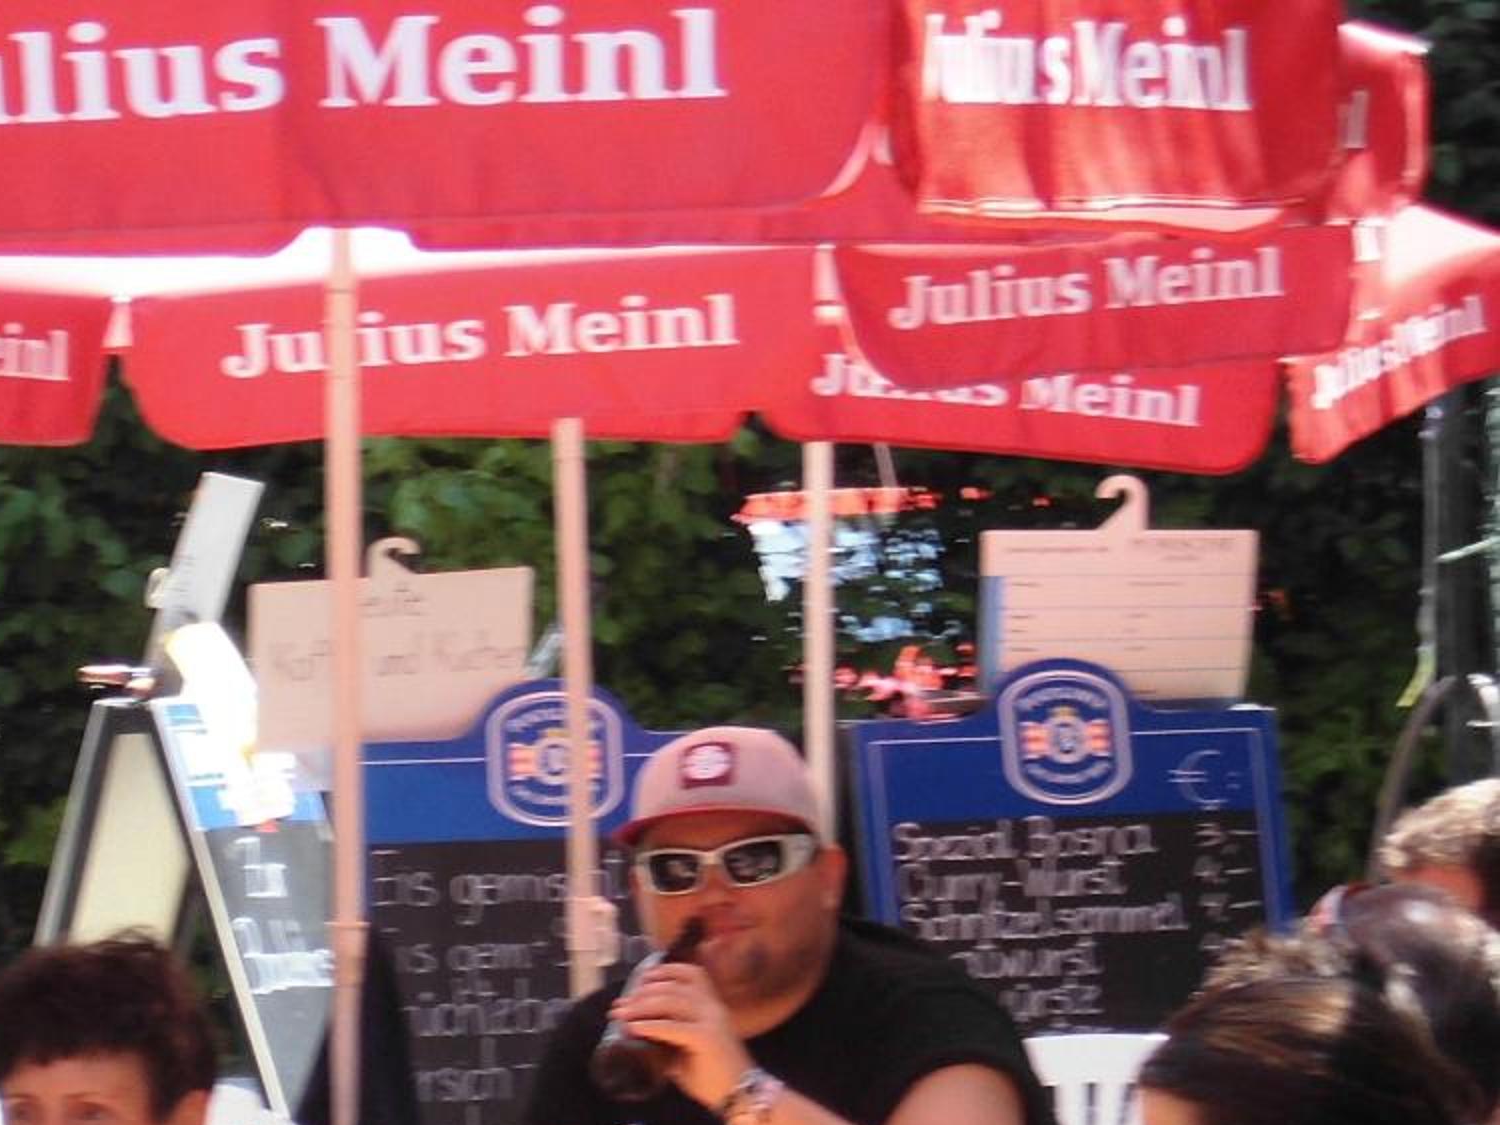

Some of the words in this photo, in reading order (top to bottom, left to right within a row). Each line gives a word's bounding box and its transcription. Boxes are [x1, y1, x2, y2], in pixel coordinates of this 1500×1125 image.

[316, 3, 727, 109] Meinl
[888, 263, 1093, 330] Julius
[1103, 246, 1285, 310] Meinl
[219, 310, 488, 380] Juius
[502, 293, 740, 358] Meinl
[1019, 373, 1201, 428] Meinl
